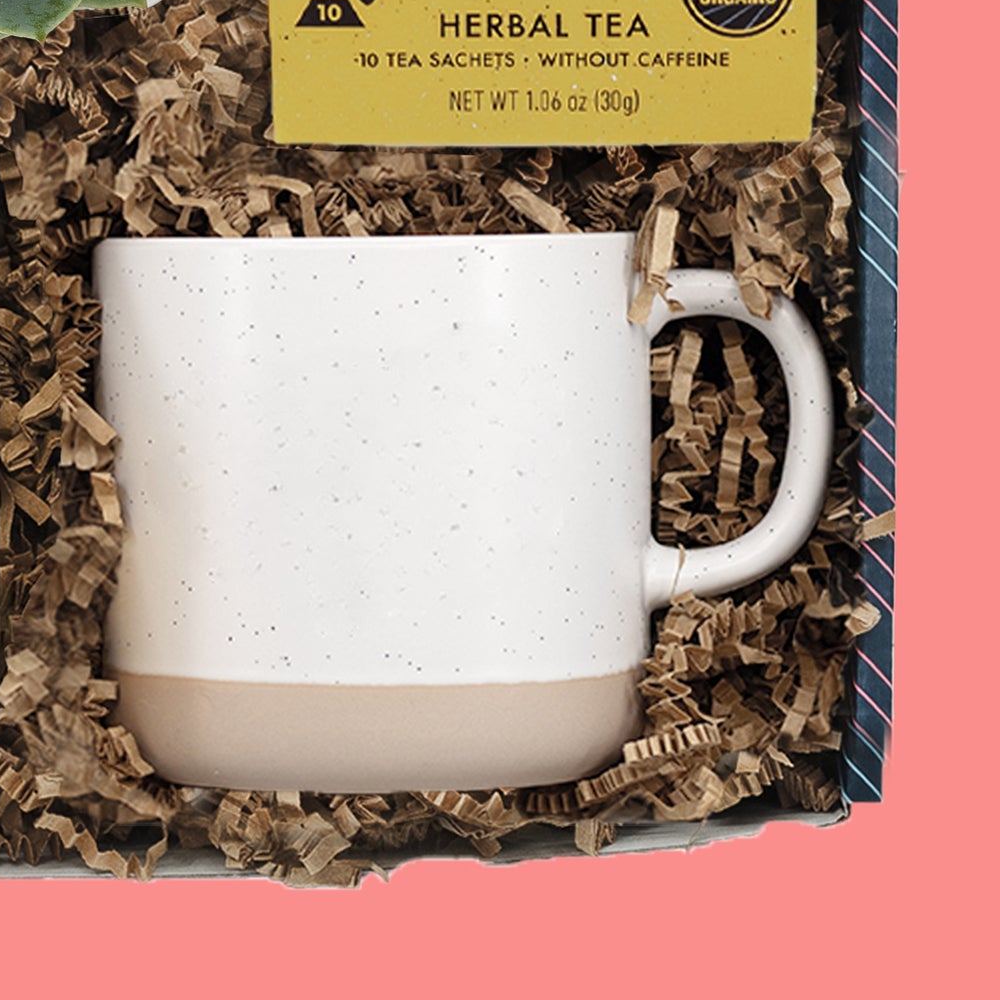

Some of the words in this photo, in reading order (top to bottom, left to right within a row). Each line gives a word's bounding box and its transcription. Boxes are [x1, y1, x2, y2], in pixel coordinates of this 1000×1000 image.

[314, 2, 343, 22] 10
[439, 11, 570, 38] HERBAL
[584, 14, 651, 37] TEA
[357, 51, 380, 68] 10
[385, 51, 423, 68] TEA
[428, 51, 517, 68] SACHETS
[536, 51, 629, 68] WITHOUT
[637, 51, 731, 67] CAFFEINE
[447, 90, 485, 113] NET
[489, 90, 519, 112] WT
[524, 90, 562, 112] 1.06
[566, 93, 588, 112] oz
[593, 88, 641, 115] (30g)
